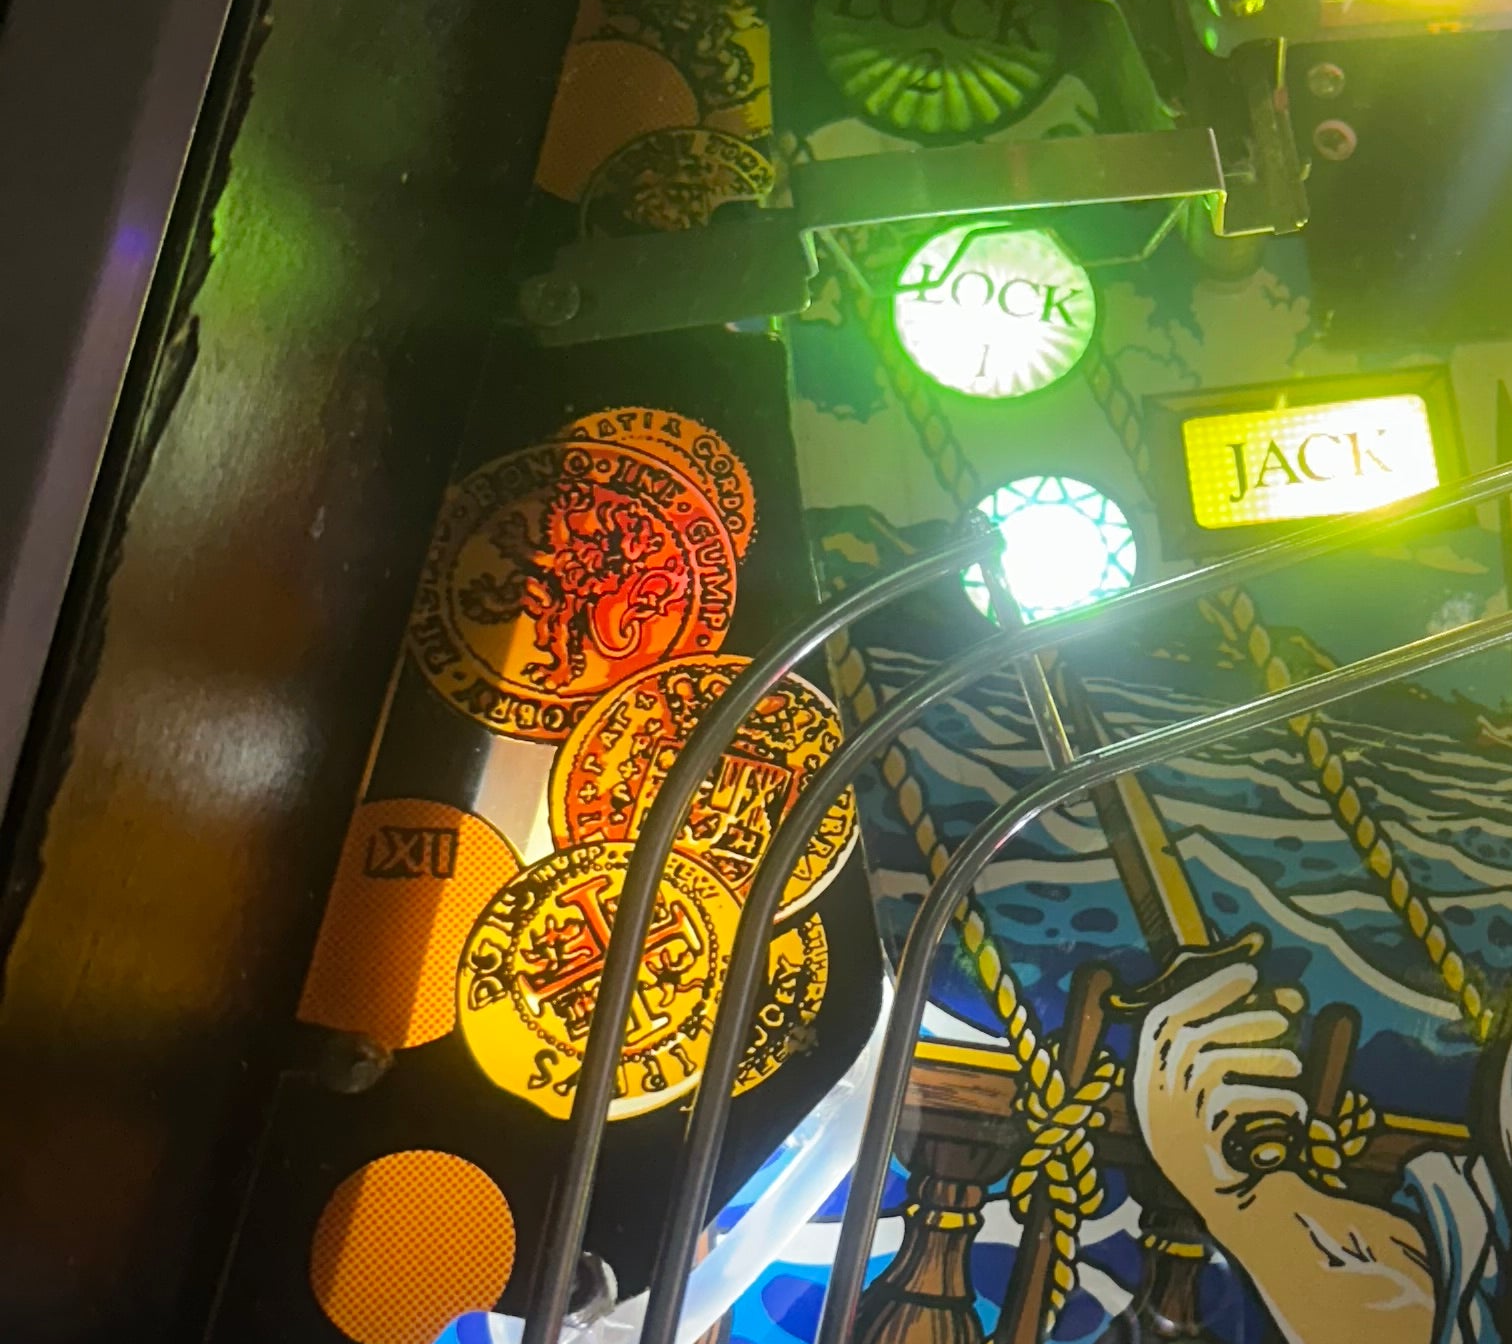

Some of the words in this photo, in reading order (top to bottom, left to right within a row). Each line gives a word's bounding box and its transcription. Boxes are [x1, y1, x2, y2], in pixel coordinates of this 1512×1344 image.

[904, 47, 945, 95] 2
[908, 263, 1086, 329] LOCK
[1227, 427, 1394, 503] JACK
[684, 514, 735, 633] GUMP
